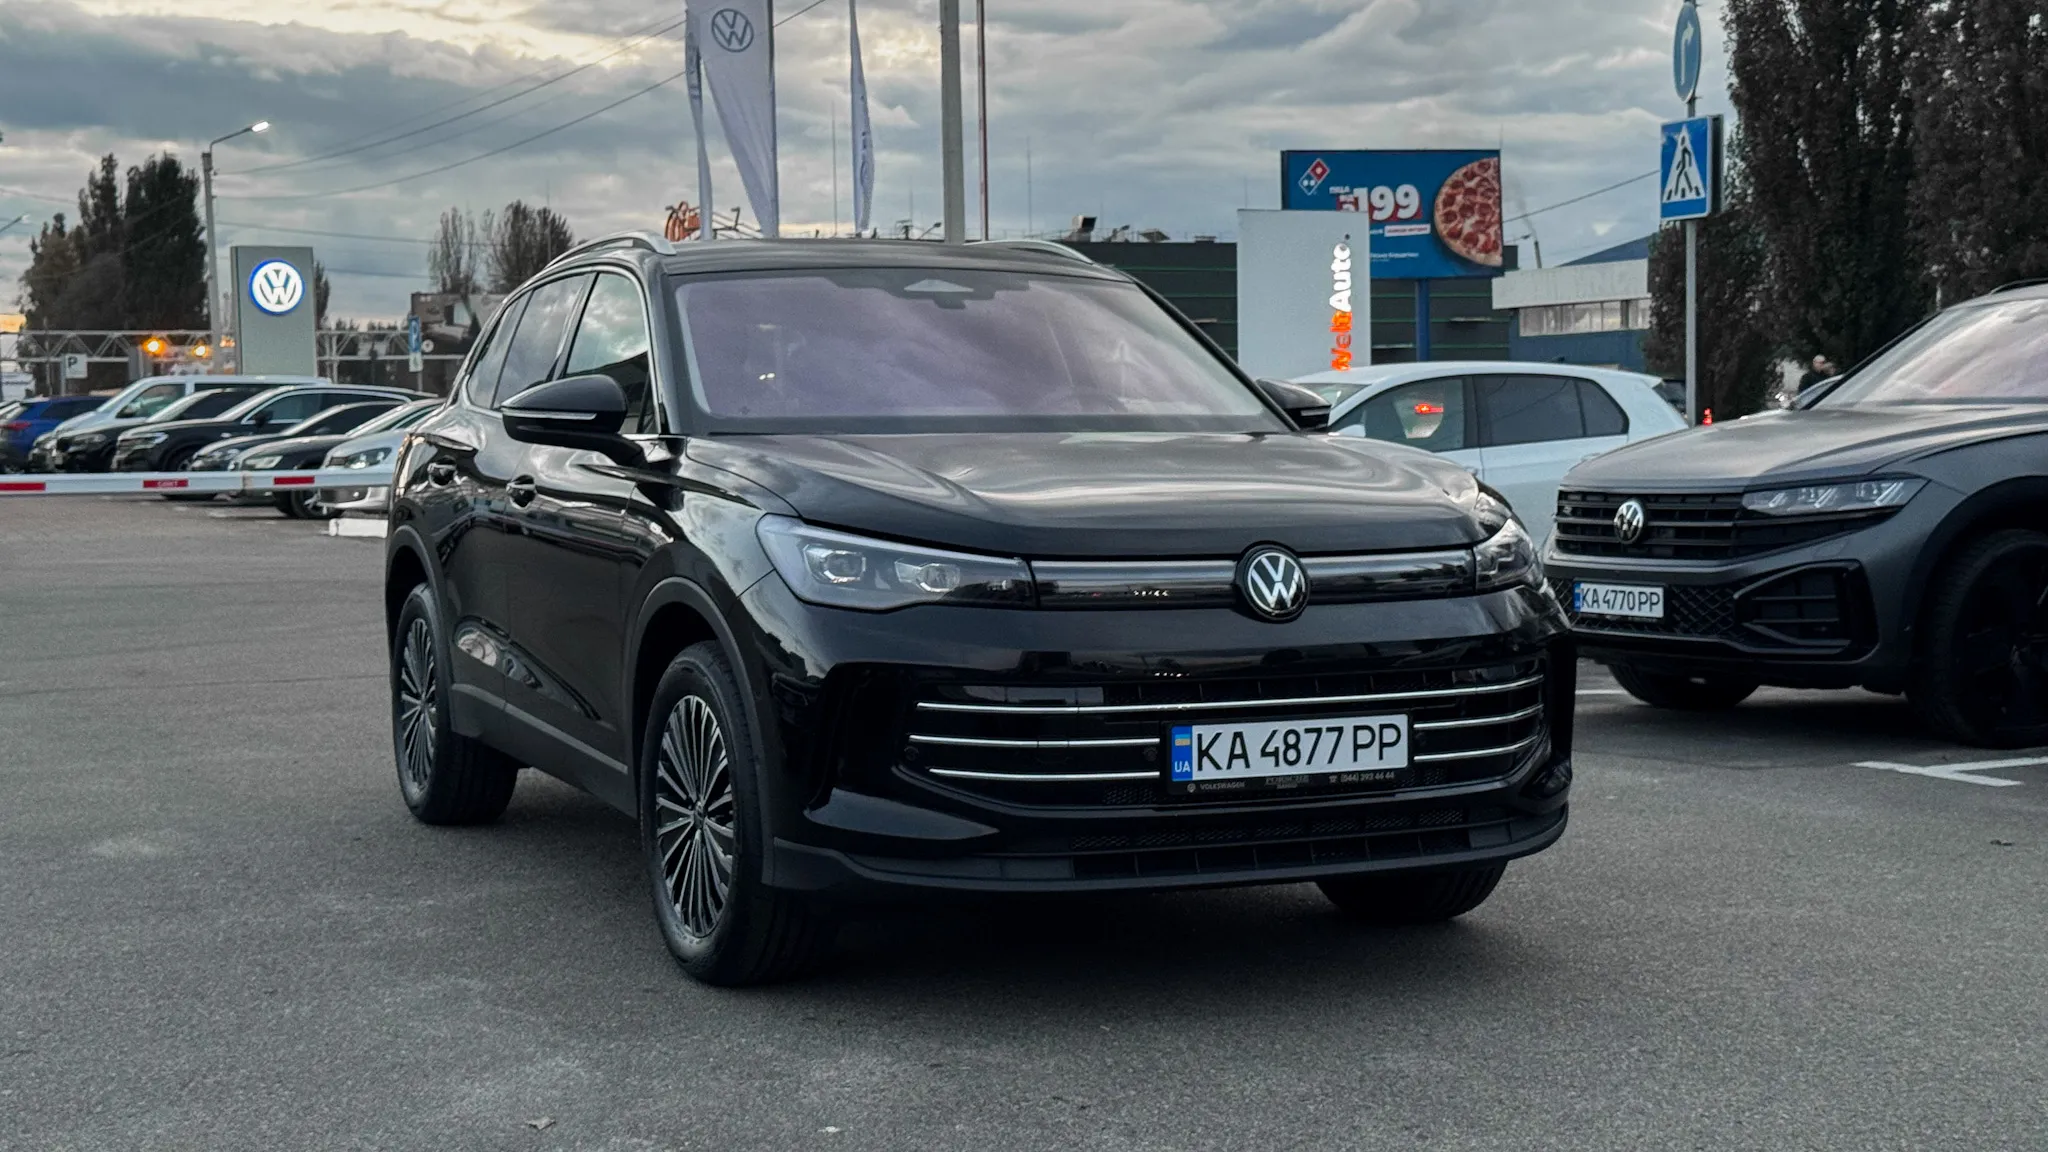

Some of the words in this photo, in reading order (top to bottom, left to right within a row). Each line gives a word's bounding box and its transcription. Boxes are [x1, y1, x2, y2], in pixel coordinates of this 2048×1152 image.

[1353, 183, 1420, 220] 199
[67, 355, 79, 368] P
[1581, 587, 1600, 609] KA
[1602, 588, 1636, 611] 4770
[1637, 591, 1661, 613] PP
[1196, 731, 1251, 772] KA
[1260, 726, 1345, 768] 4877
[1352, 722, 1402, 763] PP
[1174, 760, 1191, 774] UA
[1200, 781, 1246, 791] VOLKSWAGEN
